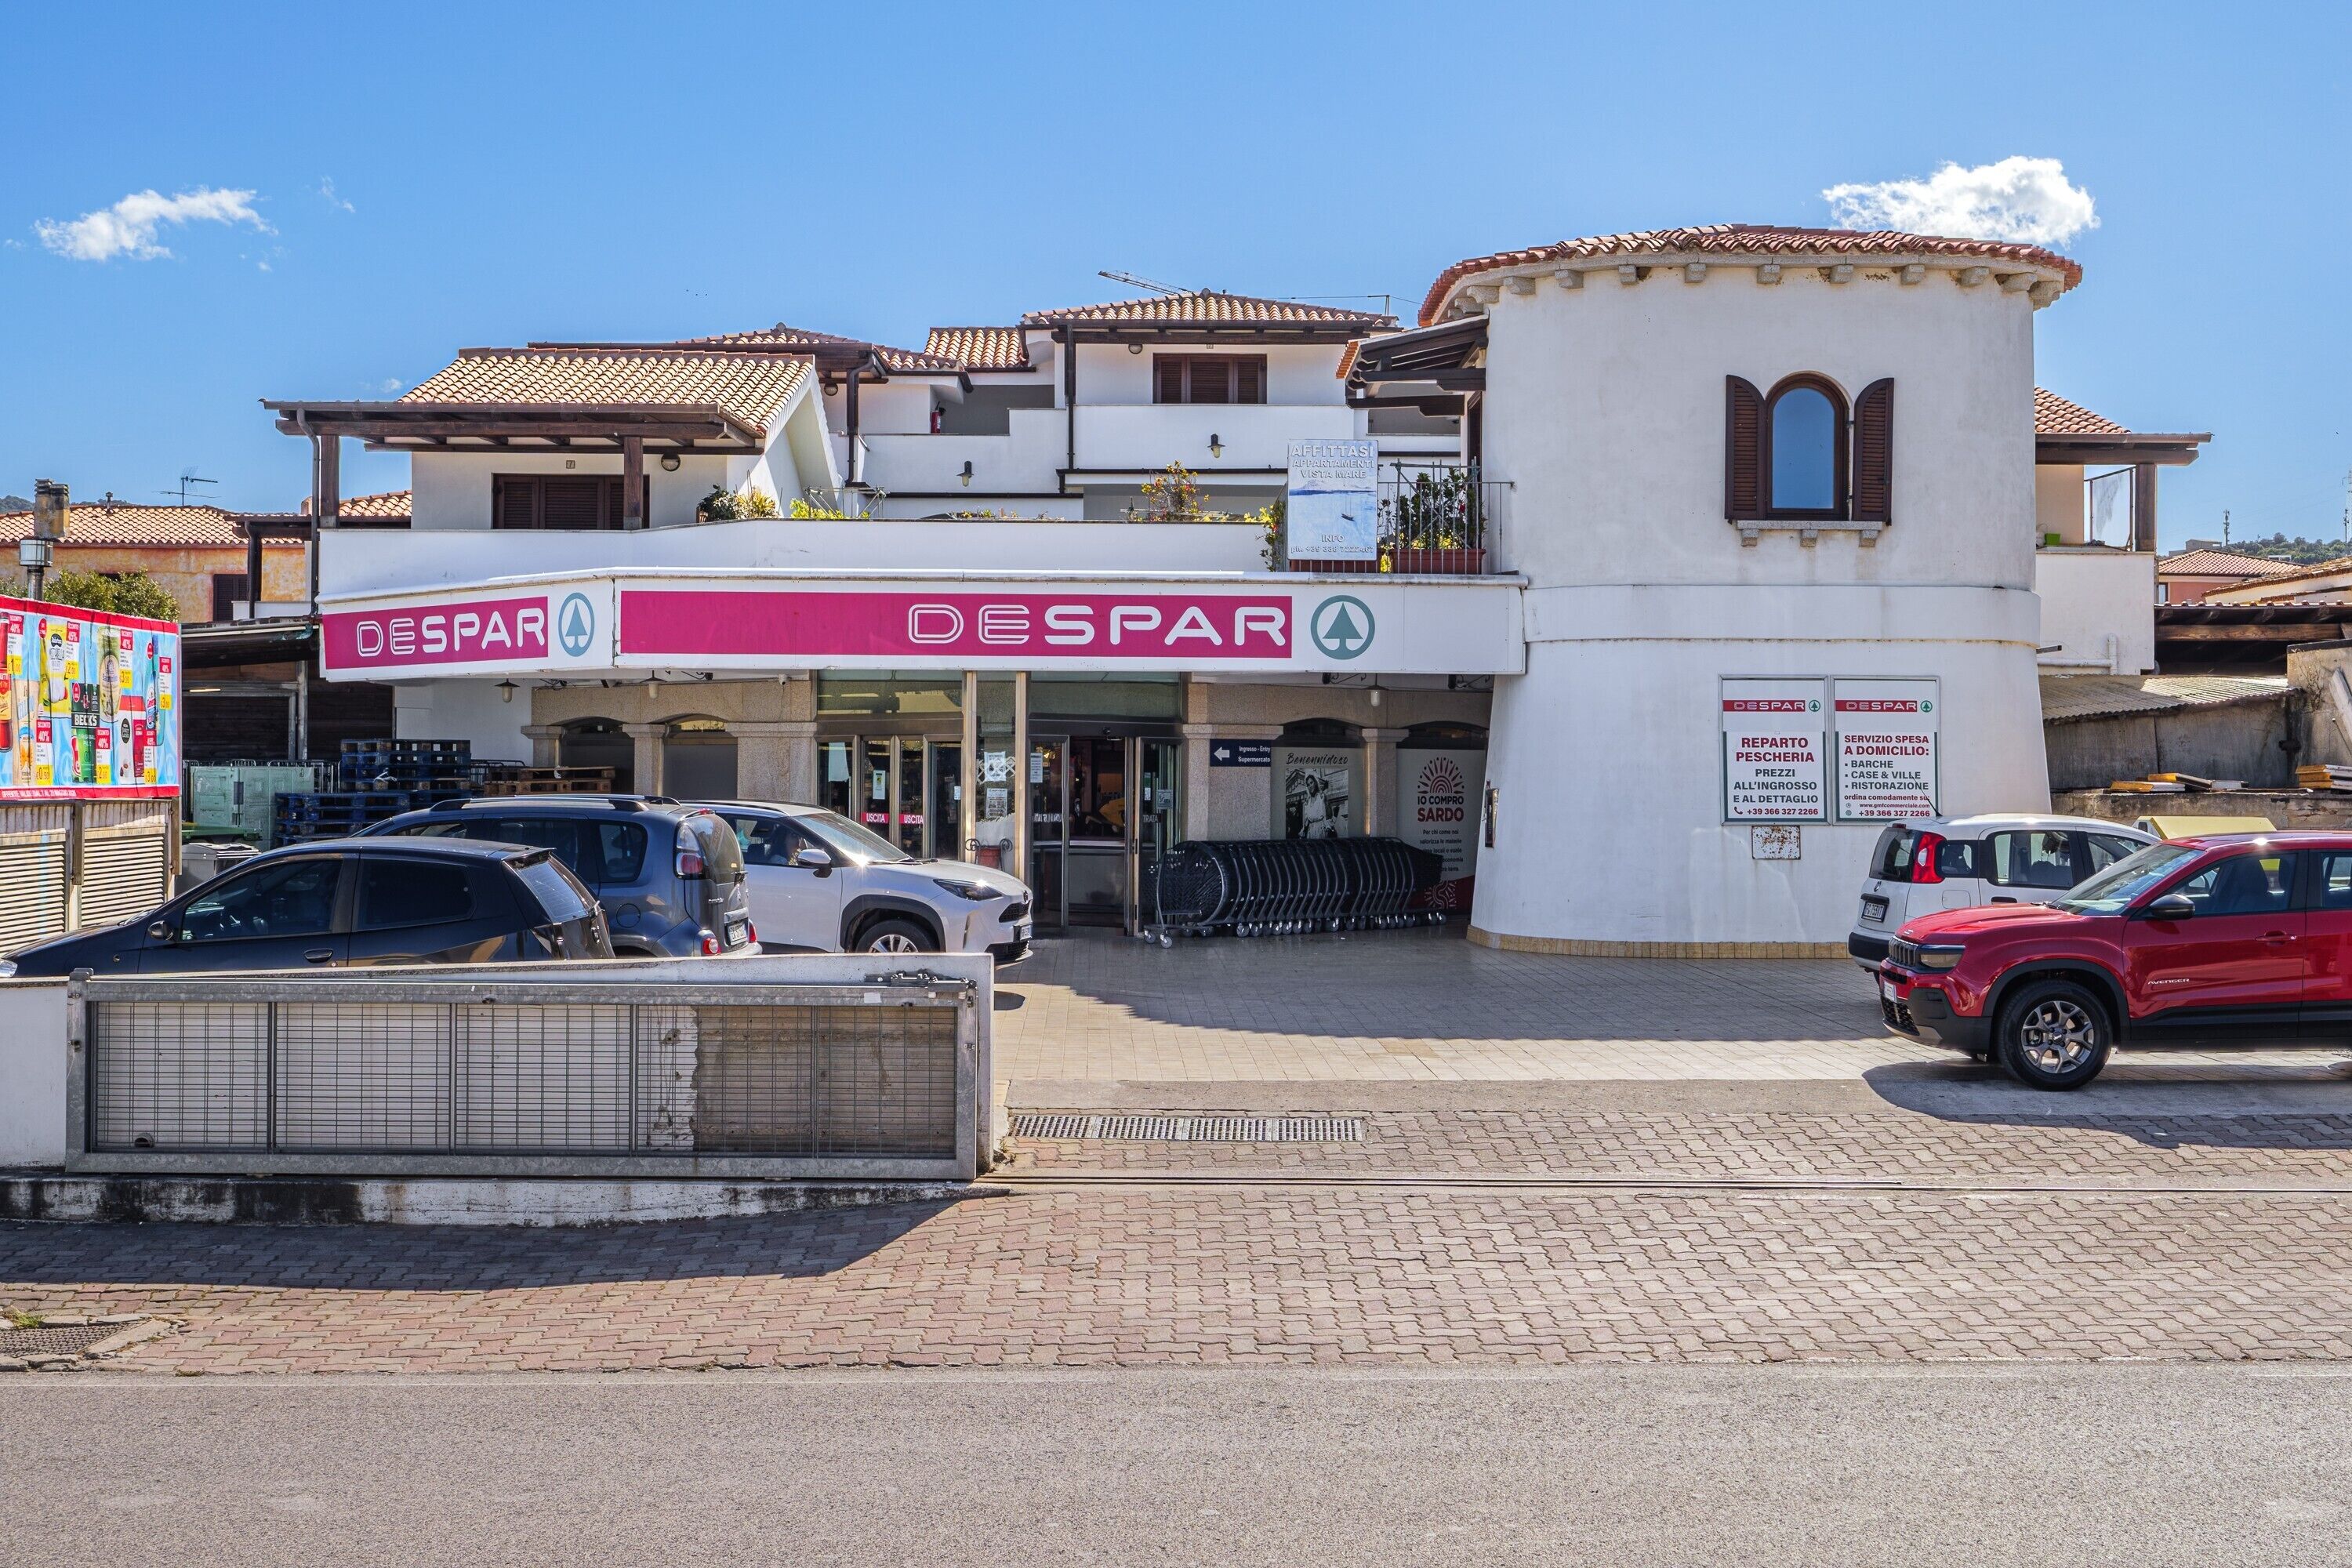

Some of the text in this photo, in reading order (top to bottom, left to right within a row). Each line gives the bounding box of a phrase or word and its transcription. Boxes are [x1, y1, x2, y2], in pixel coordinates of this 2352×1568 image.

[1290, 445, 1374, 457] AFFITTASI
[1335, 470, 1367, 479] MARE
[908, 604, 1286, 646] DESPAR
[356, 608, 546, 658] DESPAR
[1734, 702, 1805, 710] DESPAR
[1846, 702, 1917, 710] DESPAR
[74, 713, 97, 727] BECK'S
[38, 731, 50, 742] 40%
[98, 739, 108, 749] 40%
[1741, 737, 1809, 748] REPARTO
[1844, 746, 1929, 756] A DOMICILIO:
[1736, 752, 1815, 762] PESCHERIA
[1851, 760, 1894, 768] BARCHE
[1755, 768, 1795, 777] PREZZI
[1891, 771, 1921, 779] VILLE
[1733, 781, 1817, 790] ALL'INGROSSO
[1851, 782, 1929, 790] RISTORAZIONE
[1417, 796, 1465, 805] IO COMPRO
[866, 813, 886, 823] USCITA
[904, 815, 924, 824] USCITA
[1417, 808, 1465, 822] SARDO
